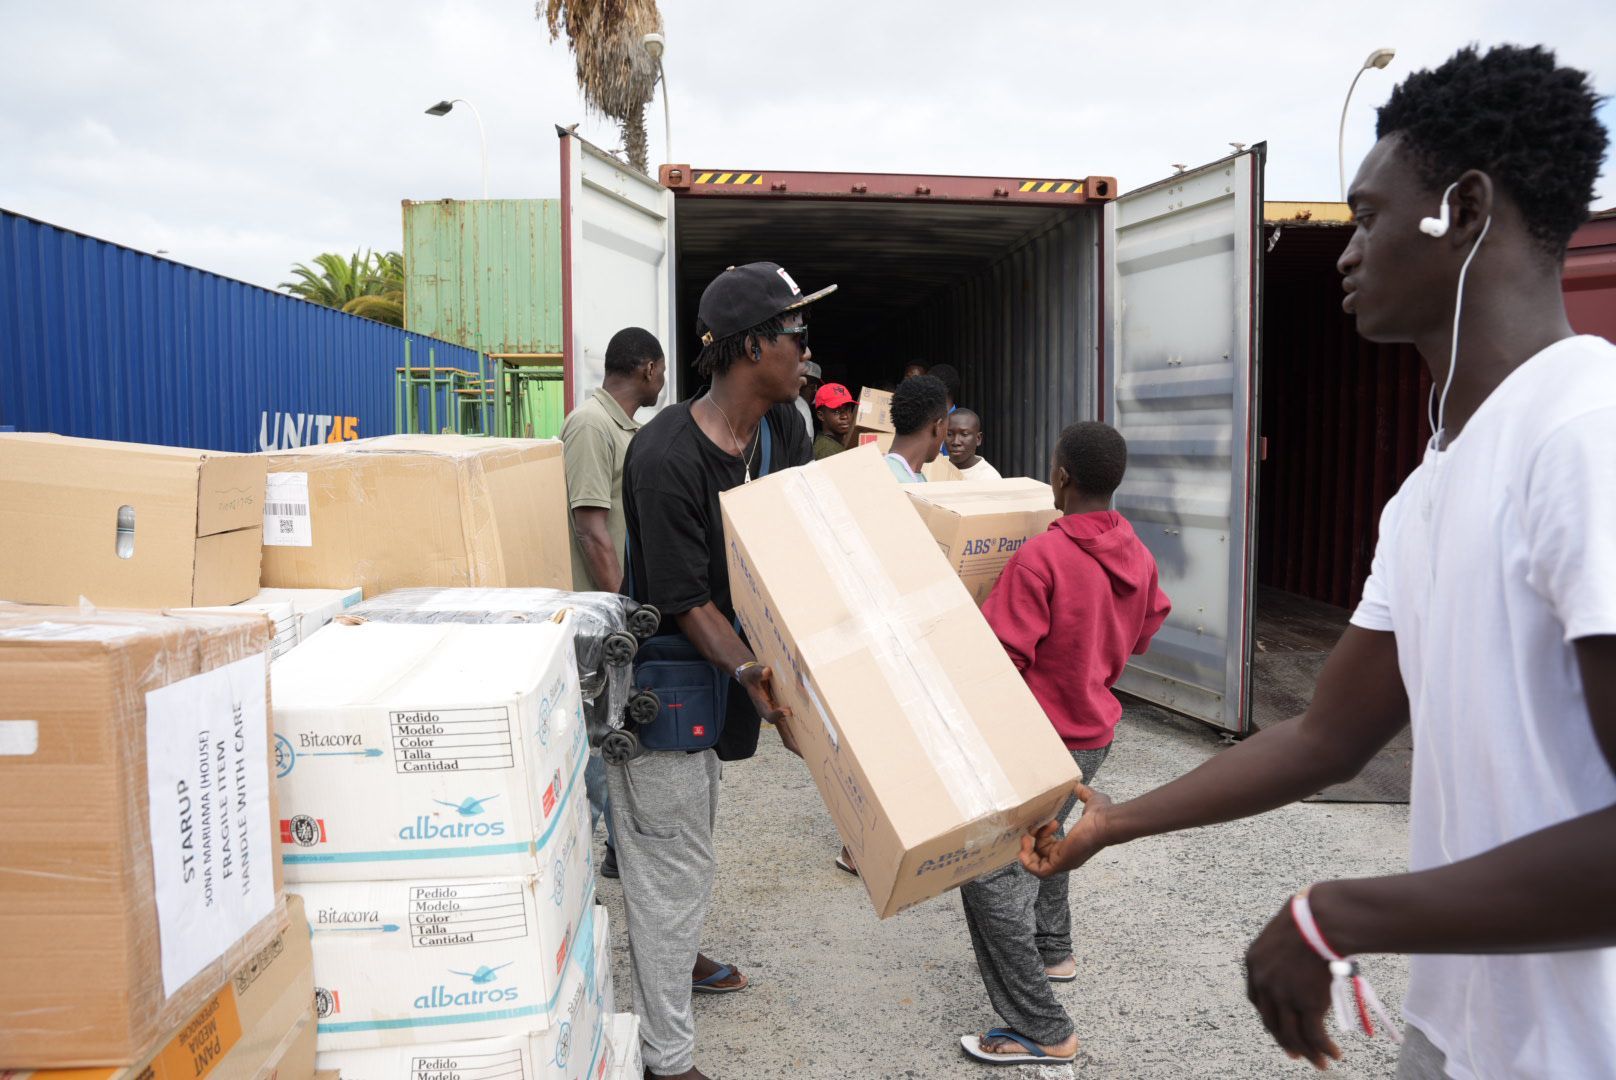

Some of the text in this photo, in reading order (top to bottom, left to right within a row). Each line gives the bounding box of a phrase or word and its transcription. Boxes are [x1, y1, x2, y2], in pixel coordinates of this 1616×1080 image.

[396, 712, 440, 723] Pedido
[398, 725, 444, 735] Modelo
[299, 732, 362, 748] Bitacora
[400, 737, 434, 748] Color
[401, 749, 431, 760] Talla
[403, 760, 459, 771] Cantidad
[233, 701, 251, 896] HANDLE WITH CARE
[216, 741, 233, 879] FRAGILE ITEM
[199, 730, 213, 907] SONA MARIAMA (HOUSE)
[399, 816, 505, 840] albatros
[416, 888, 457, 899] Pedido
[415, 900, 460, 912] Modelo
[317, 907, 380, 924] Bitacora
[416, 914, 451, 925] Color
[417, 925, 447, 935] Talla
[418, 934, 474, 946] Cantidad
[413, 986, 519, 1009] albatros
[418, 1059, 458, 1069] Pedido
[417, 1072, 460, 1080] Modelo
